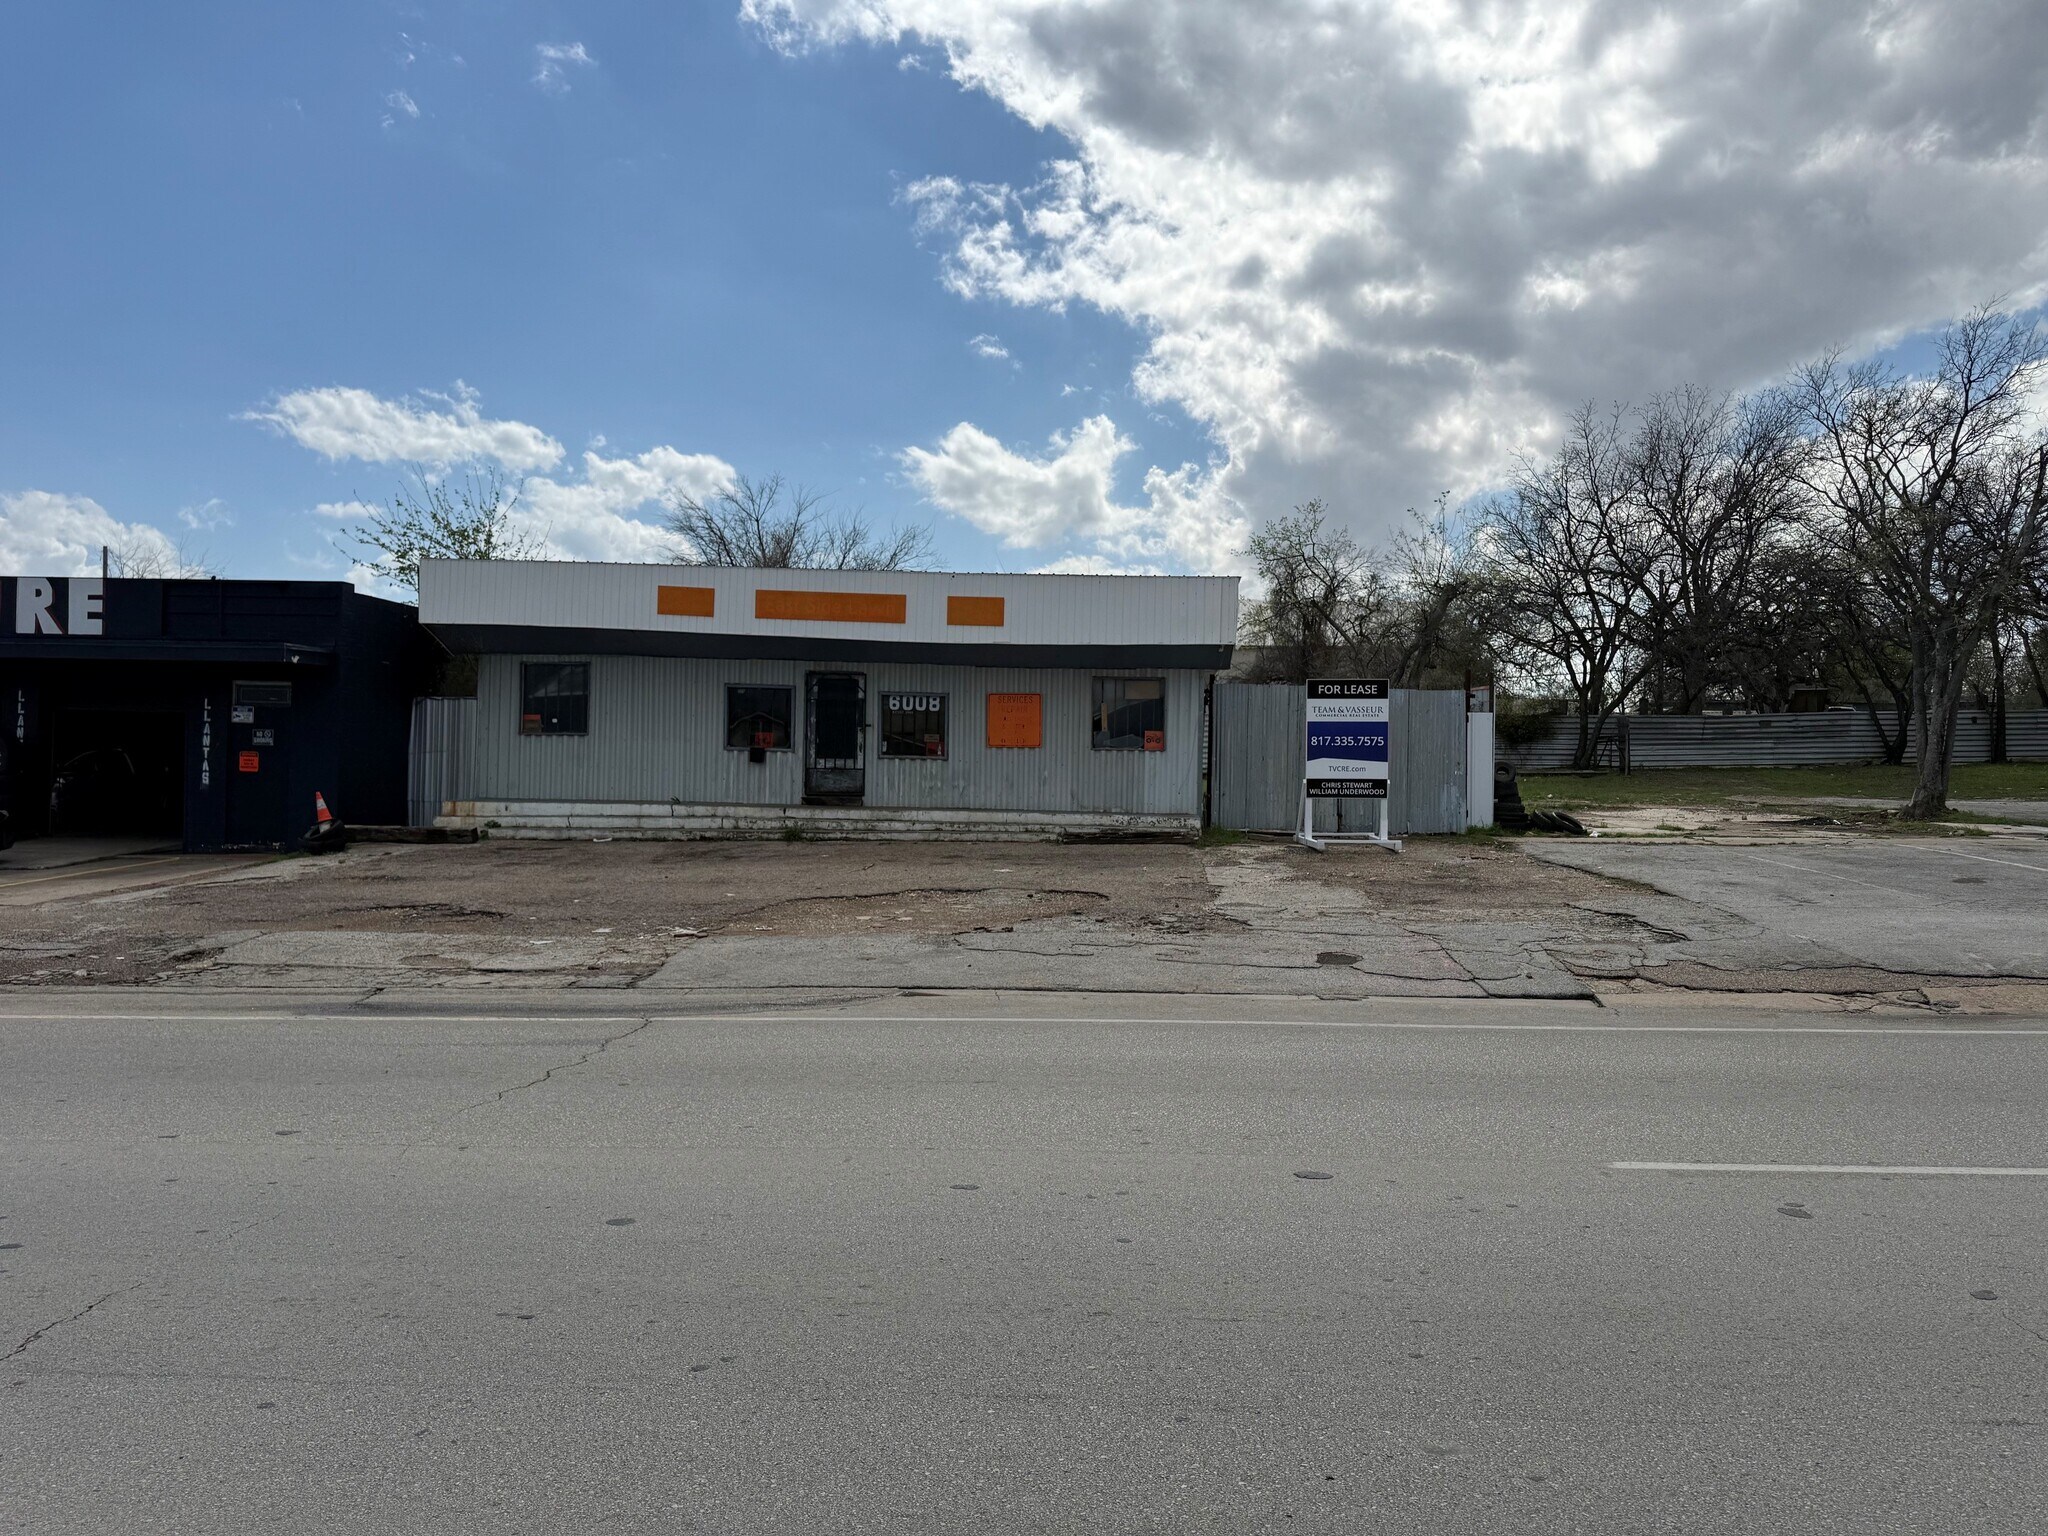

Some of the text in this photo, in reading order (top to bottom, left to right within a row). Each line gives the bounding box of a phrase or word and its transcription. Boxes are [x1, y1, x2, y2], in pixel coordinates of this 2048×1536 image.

[1318, 685, 1378, 695] FOR LEASE
[889, 696, 941, 712] 6008
[997, 695, 1033, 704] SERVICES
[16, 689, 25, 743] LLAN
[202, 698, 211, 784] LLANTAS
[1311, 736, 1385, 746] 817.335.7575
